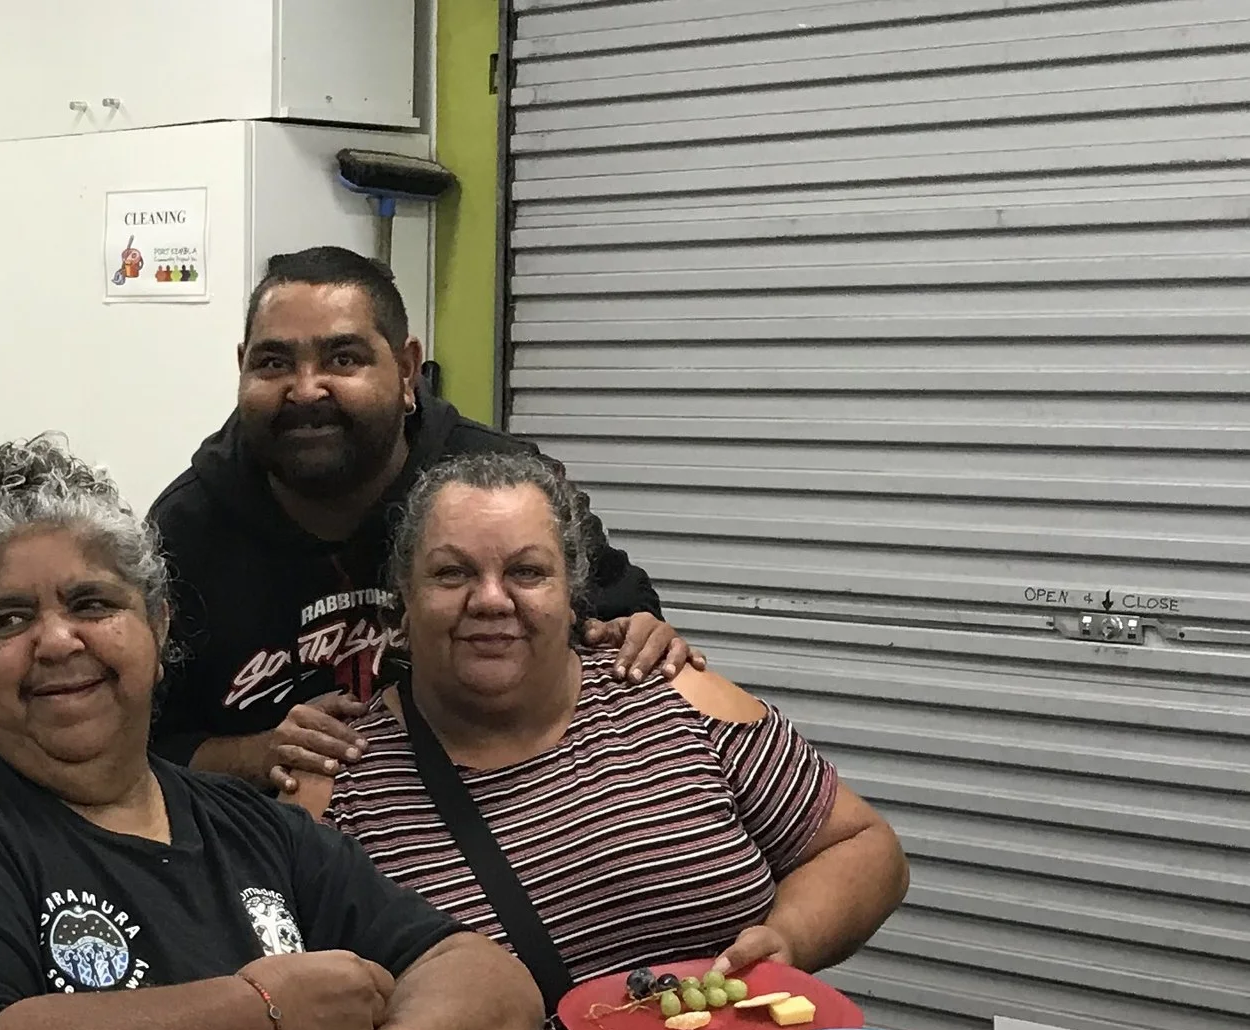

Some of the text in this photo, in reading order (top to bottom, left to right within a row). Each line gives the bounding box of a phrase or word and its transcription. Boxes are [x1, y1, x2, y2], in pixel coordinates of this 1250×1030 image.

[124, 210, 187, 226] CLEANING
[1024, 587, 1069, 604] OPEN
[1122, 594, 1180, 612] CLOSE
[125, 957, 150, 990] way
